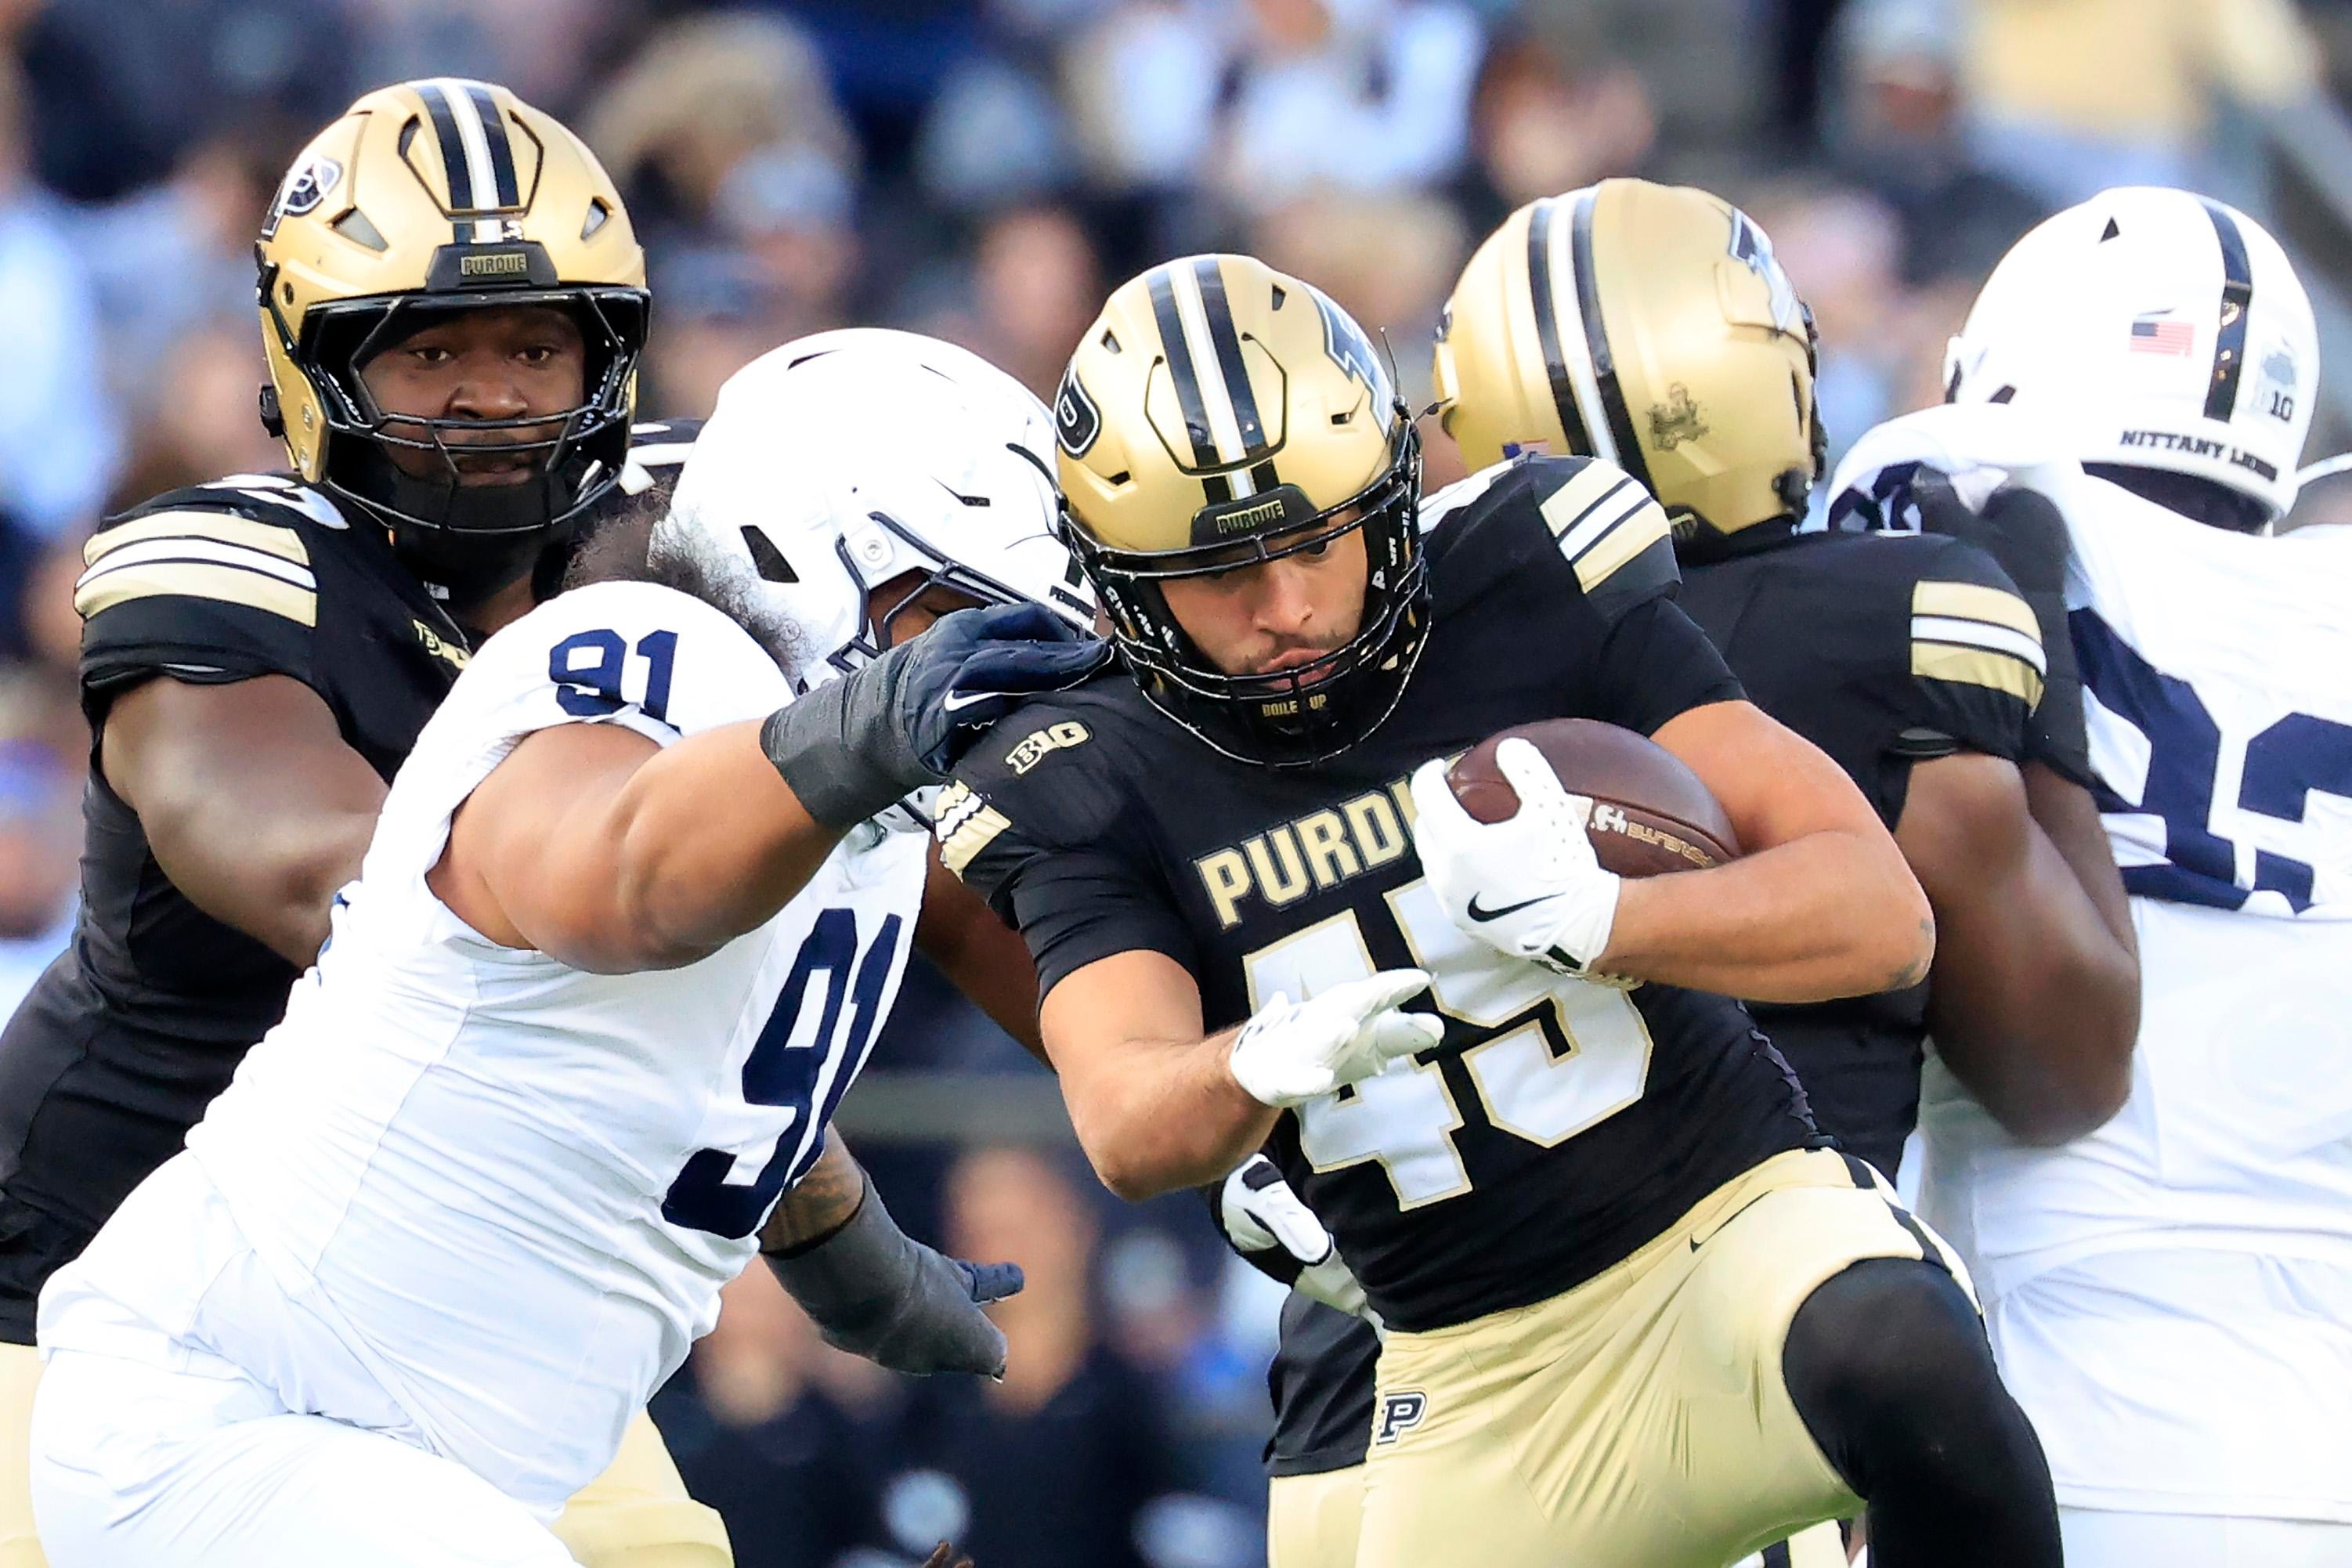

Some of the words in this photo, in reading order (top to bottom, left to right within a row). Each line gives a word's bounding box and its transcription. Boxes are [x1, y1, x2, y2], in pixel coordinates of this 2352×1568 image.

[460, 253, 528, 276] PURDUE
[2268, 391, 2293, 422] 10
[2119, 430, 2226, 459] NITTANY
[1216, 500, 1285, 535] PURDUE
[548, 628, 684, 737] 91
[1309, 693, 1327, 710] UP
[1193, 764, 1435, 930] PURD
[1242, 871, 1654, 1211] 45
[660, 907, 902, 1241] 91
[1376, 1390, 1428, 1445] P
